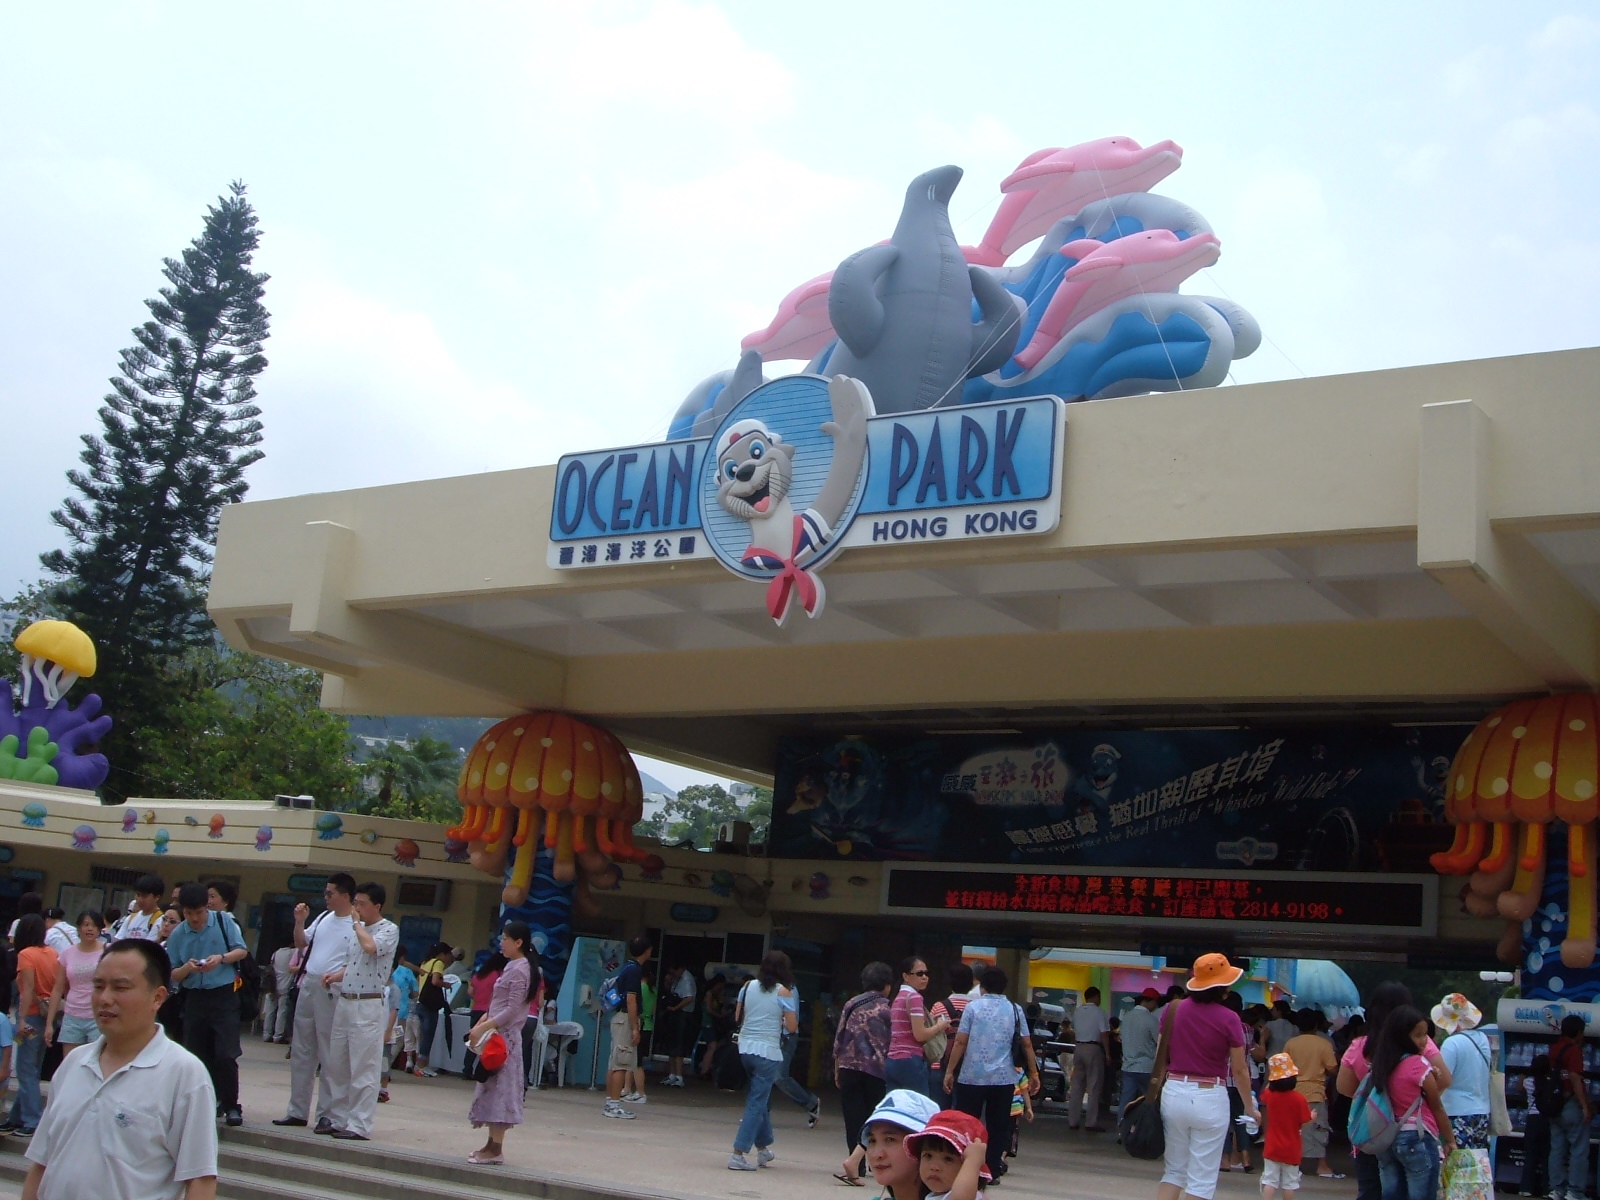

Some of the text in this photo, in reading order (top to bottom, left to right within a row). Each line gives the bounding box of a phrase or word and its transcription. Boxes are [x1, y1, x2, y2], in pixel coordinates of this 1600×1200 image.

[556, 406, 1027, 535] OCEAN PARK
[872, 508, 1039, 542] HONG KONG
[558, 535, 697, 566] 香港海洋公園
